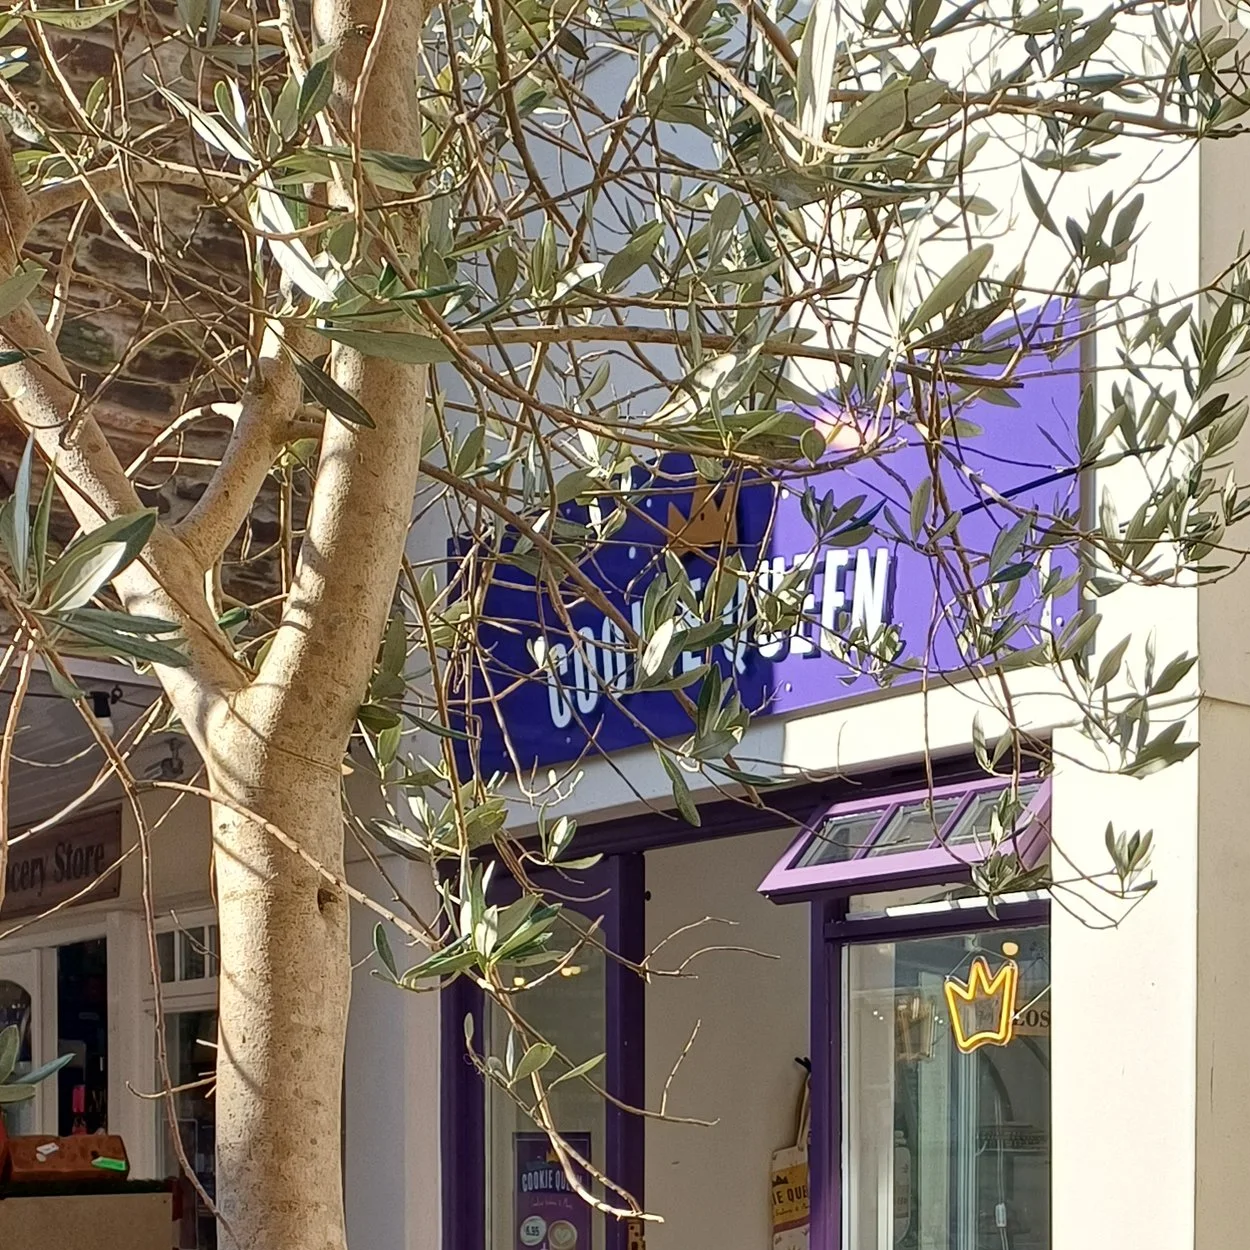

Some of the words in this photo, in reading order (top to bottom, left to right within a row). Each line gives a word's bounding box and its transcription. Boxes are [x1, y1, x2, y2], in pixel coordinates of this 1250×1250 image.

[548, 577, 703, 728] COOE
[54, 841, 105, 883] Store
[522, 1169, 553, 1193] COOKIE
